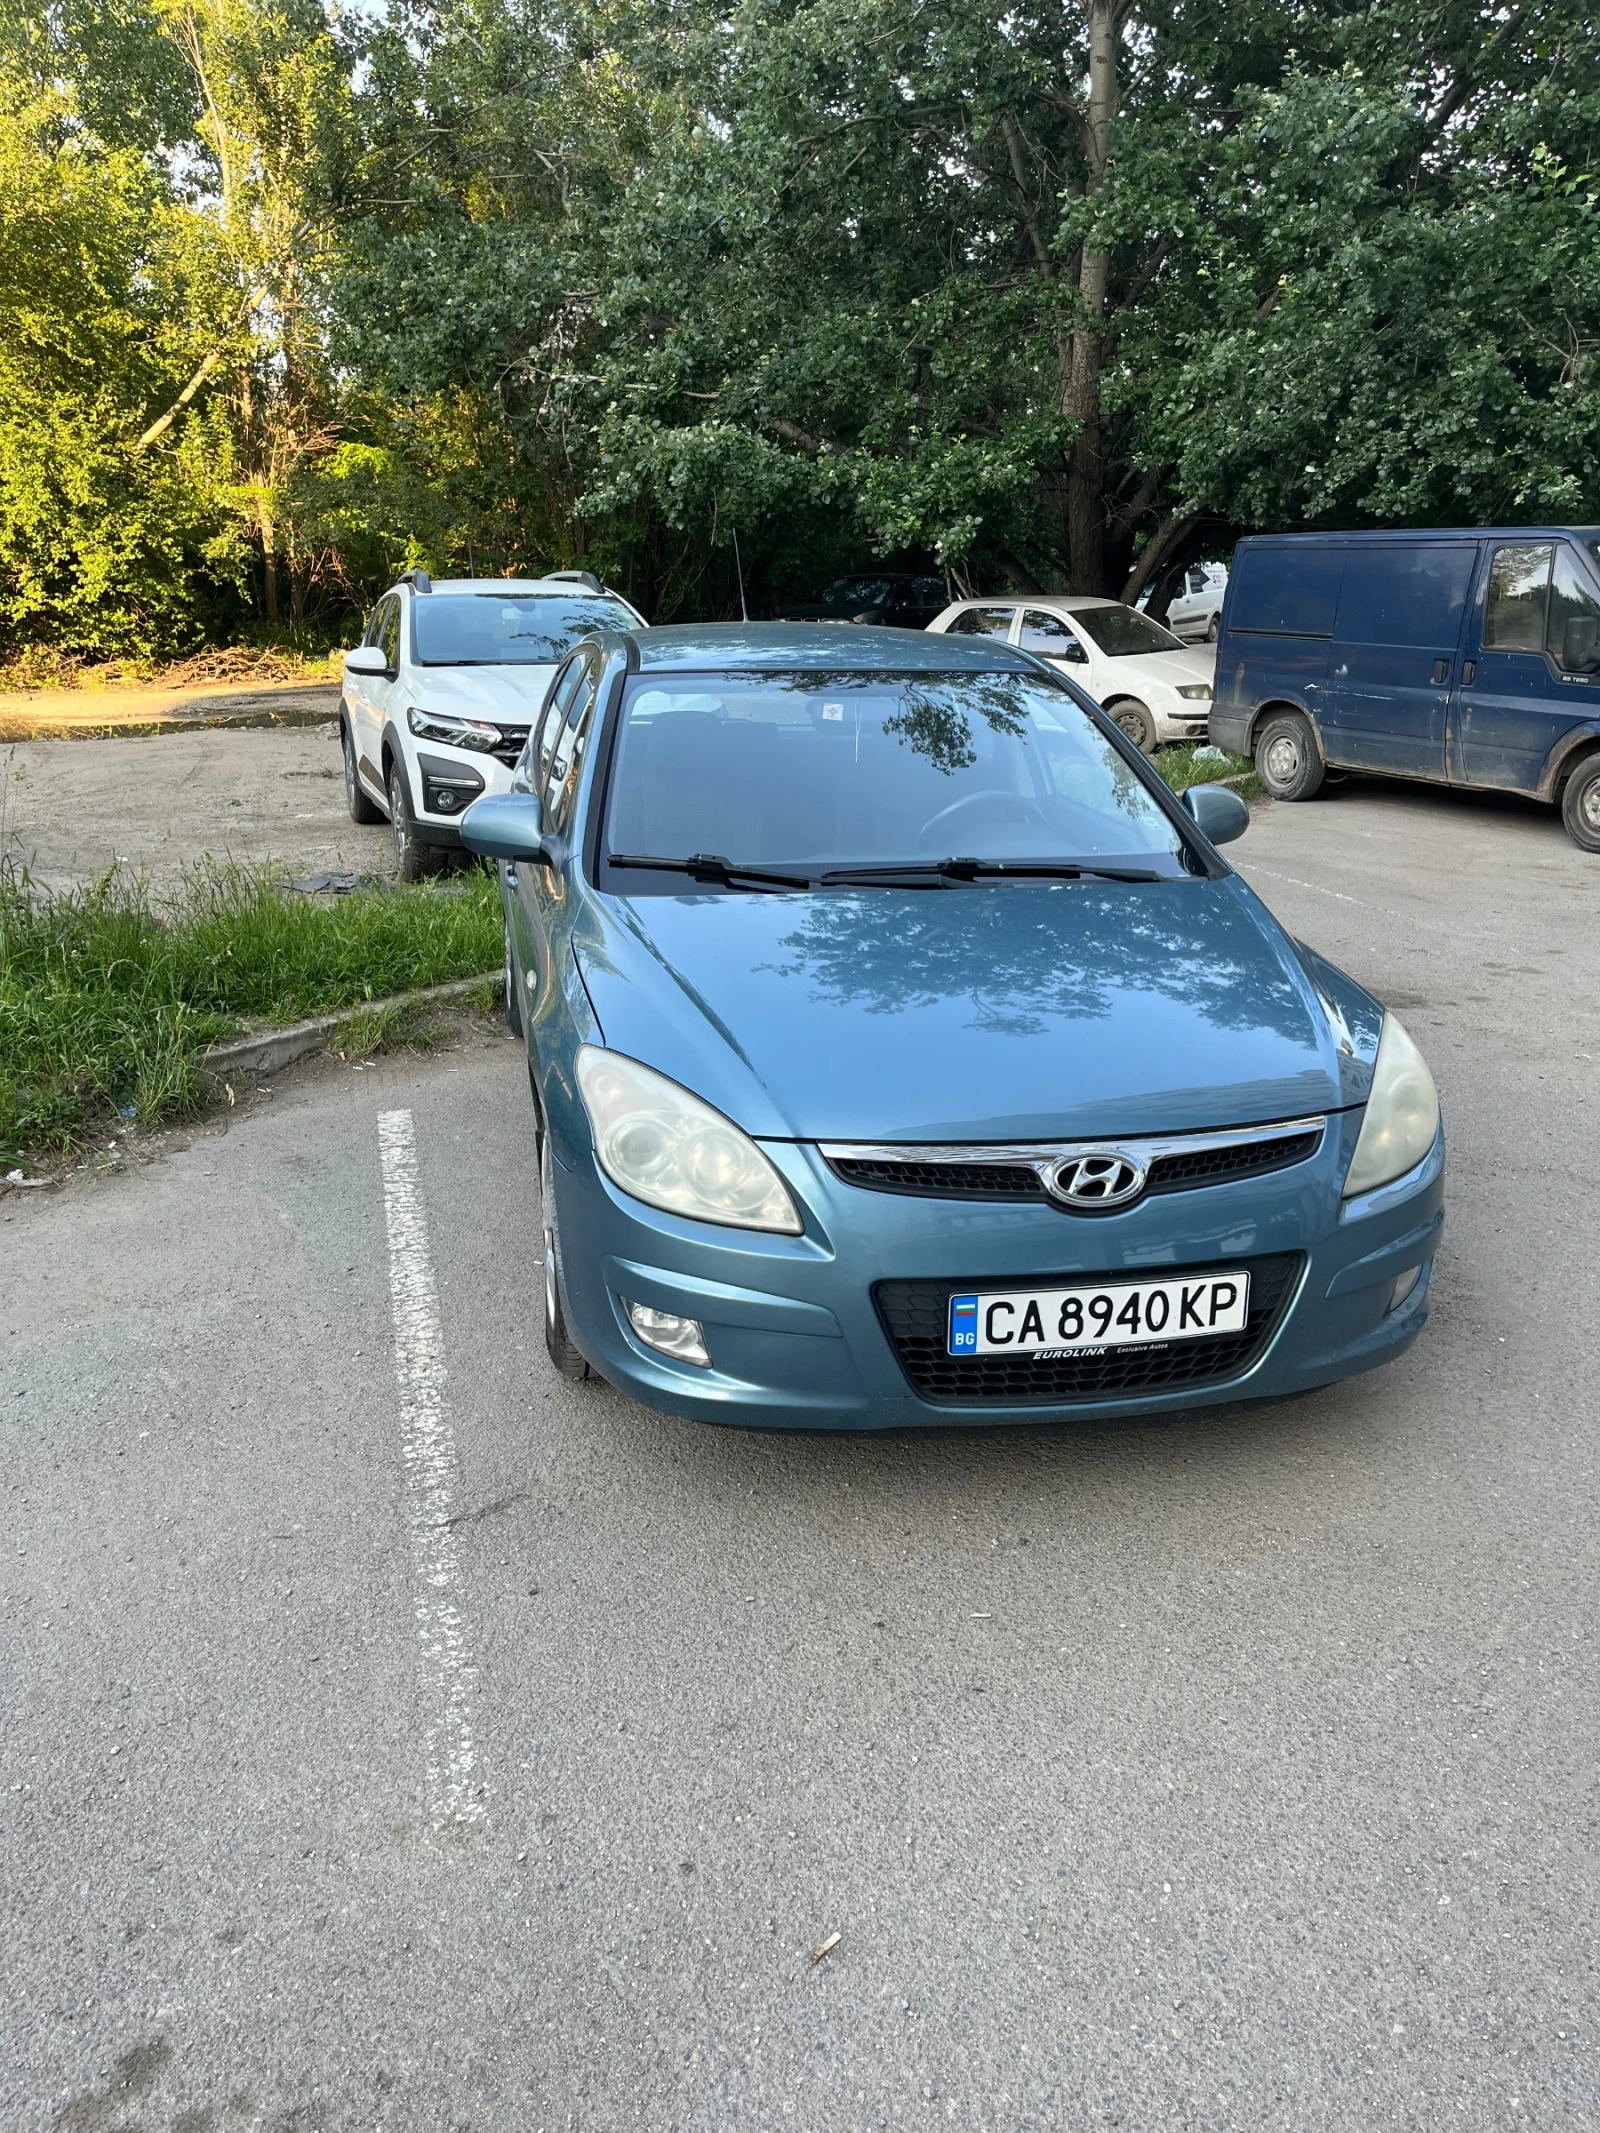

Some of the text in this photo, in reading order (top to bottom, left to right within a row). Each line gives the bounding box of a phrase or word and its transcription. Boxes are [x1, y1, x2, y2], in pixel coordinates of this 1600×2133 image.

[985, 1282, 1238, 1345] CA 8940 KP
[955, 1332, 975, 1346] BG
[1032, 1346, 1108, 1360] EUROLINK
[1116, 1346, 1148, 1354] Exclusive
